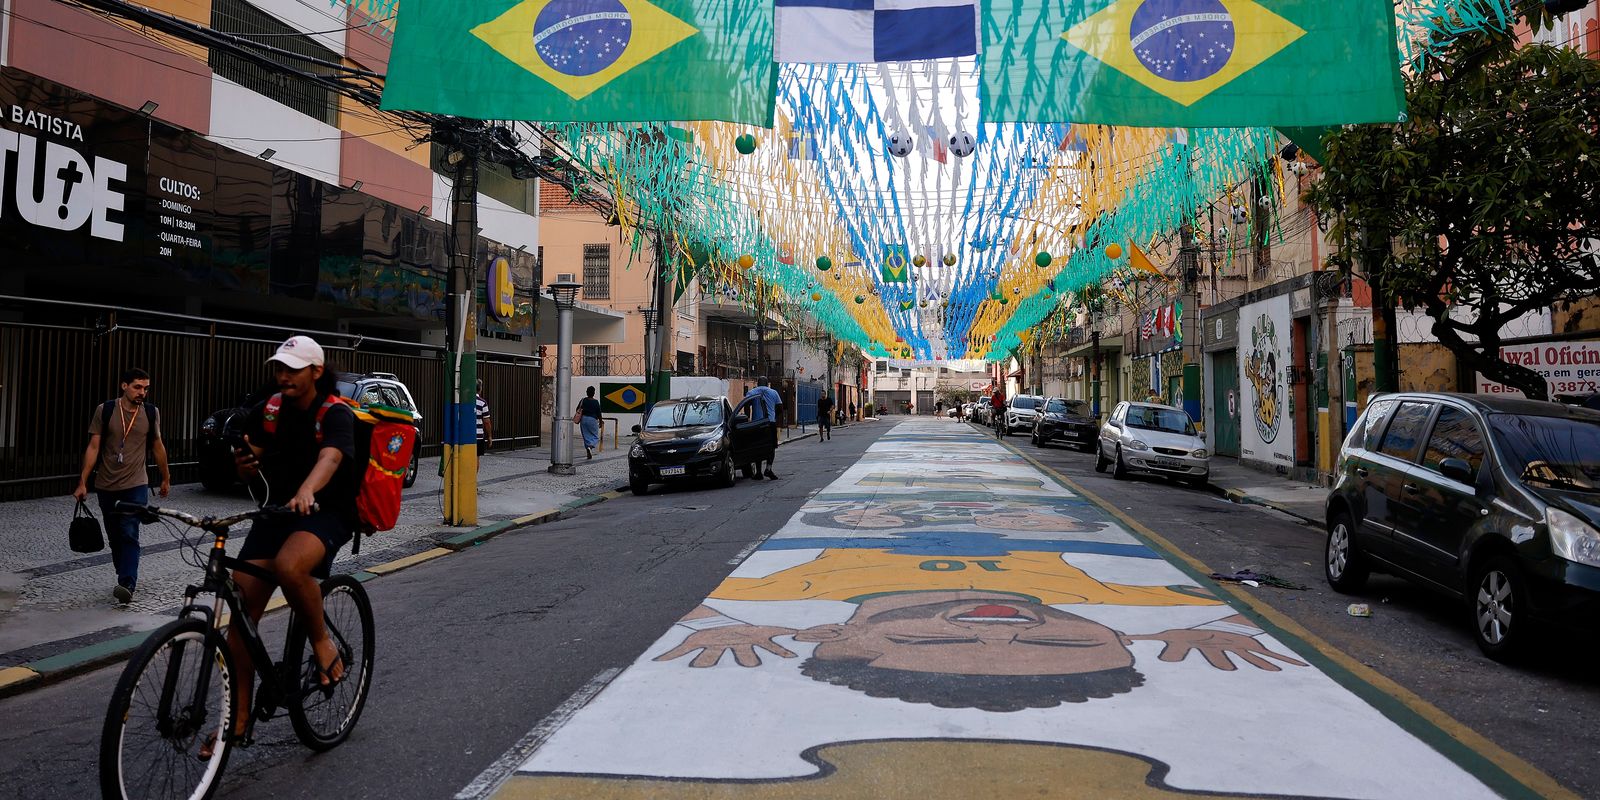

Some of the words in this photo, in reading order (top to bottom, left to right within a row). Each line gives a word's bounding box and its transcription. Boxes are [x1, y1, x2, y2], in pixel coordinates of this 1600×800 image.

[12, 104, 83, 142] BATISTA
[159, 177, 200, 200] CULTOS:
[162, 199, 192, 214] DOMINGO
[160, 231, 202, 249] QUARTA-FEIRA
[159, 247, 172, 257] 20H
